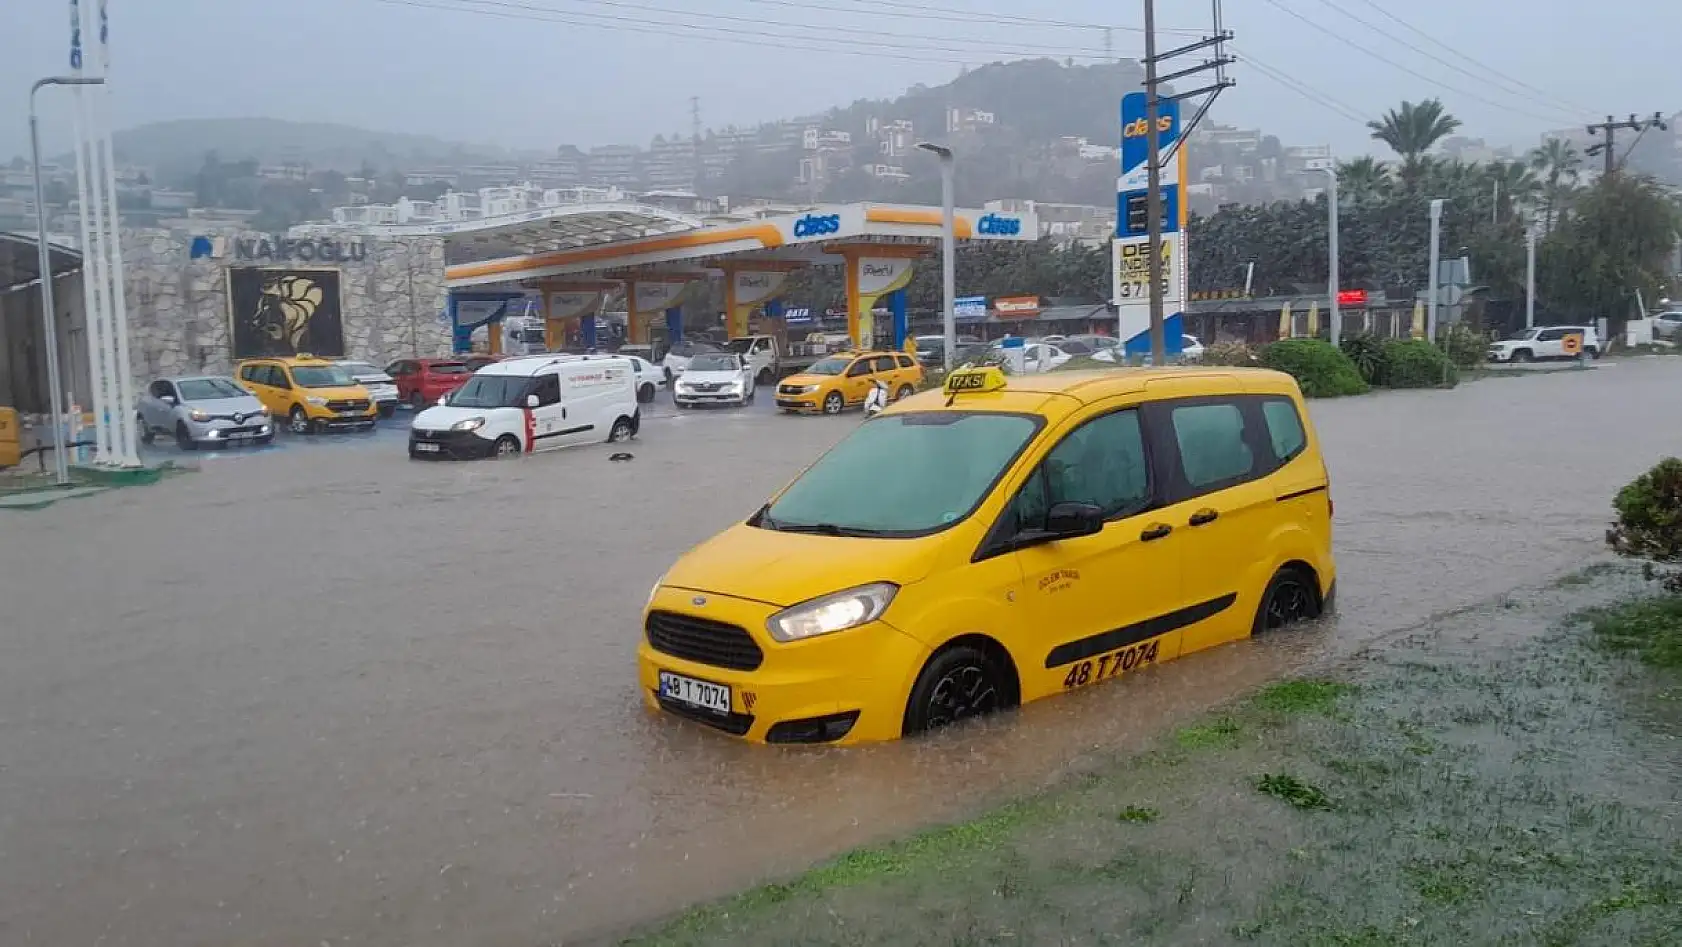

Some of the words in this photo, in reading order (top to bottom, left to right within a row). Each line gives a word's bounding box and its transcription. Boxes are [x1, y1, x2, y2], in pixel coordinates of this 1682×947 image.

[793, 213, 841, 237] class
[978, 213, 1021, 235] class
[1063, 660, 1092, 688] 48
[1095, 655, 1112, 680] T
[1110, 640, 1160, 676] 7074
[666, 675, 682, 696] 48
[684, 681, 693, 700] T
[696, 684, 729, 709] 7074
